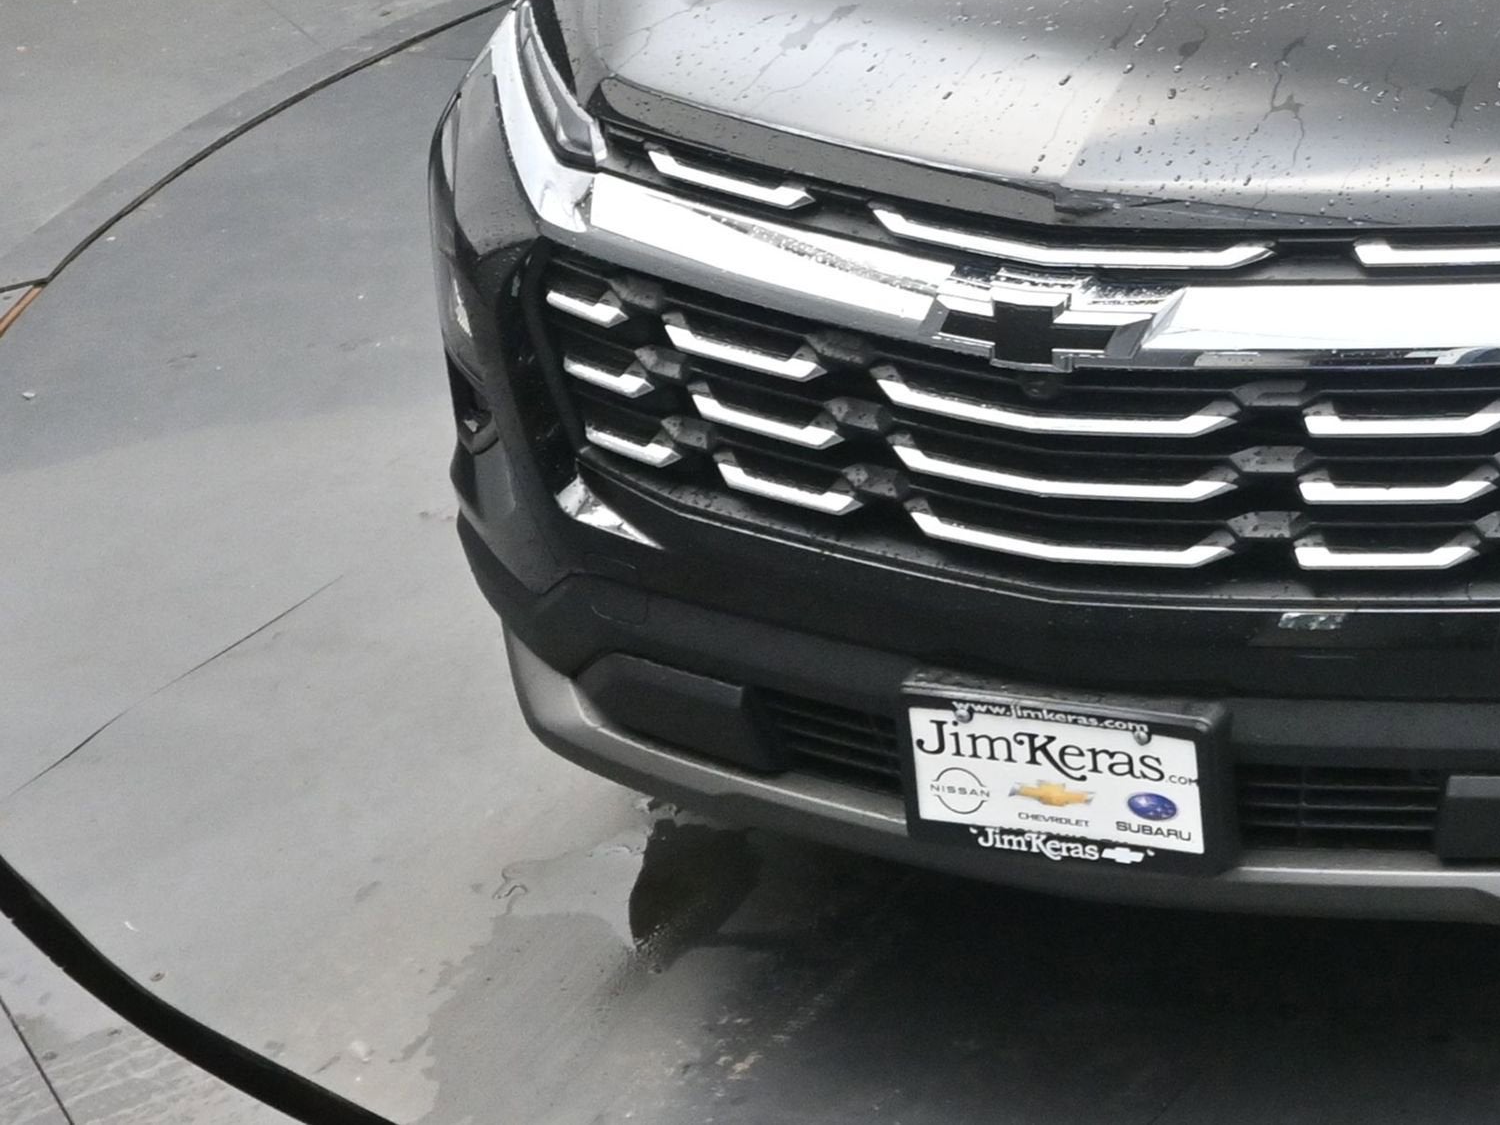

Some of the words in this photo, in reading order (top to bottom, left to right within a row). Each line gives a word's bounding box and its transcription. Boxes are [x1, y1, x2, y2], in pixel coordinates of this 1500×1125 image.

[952, 701, 1149, 732] www.jimkeras.com
[930, 783, 991, 798] NISSAN
[1018, 812, 1089, 827] CHEVROLET
[1115, 821, 1192, 841] SUBARU
